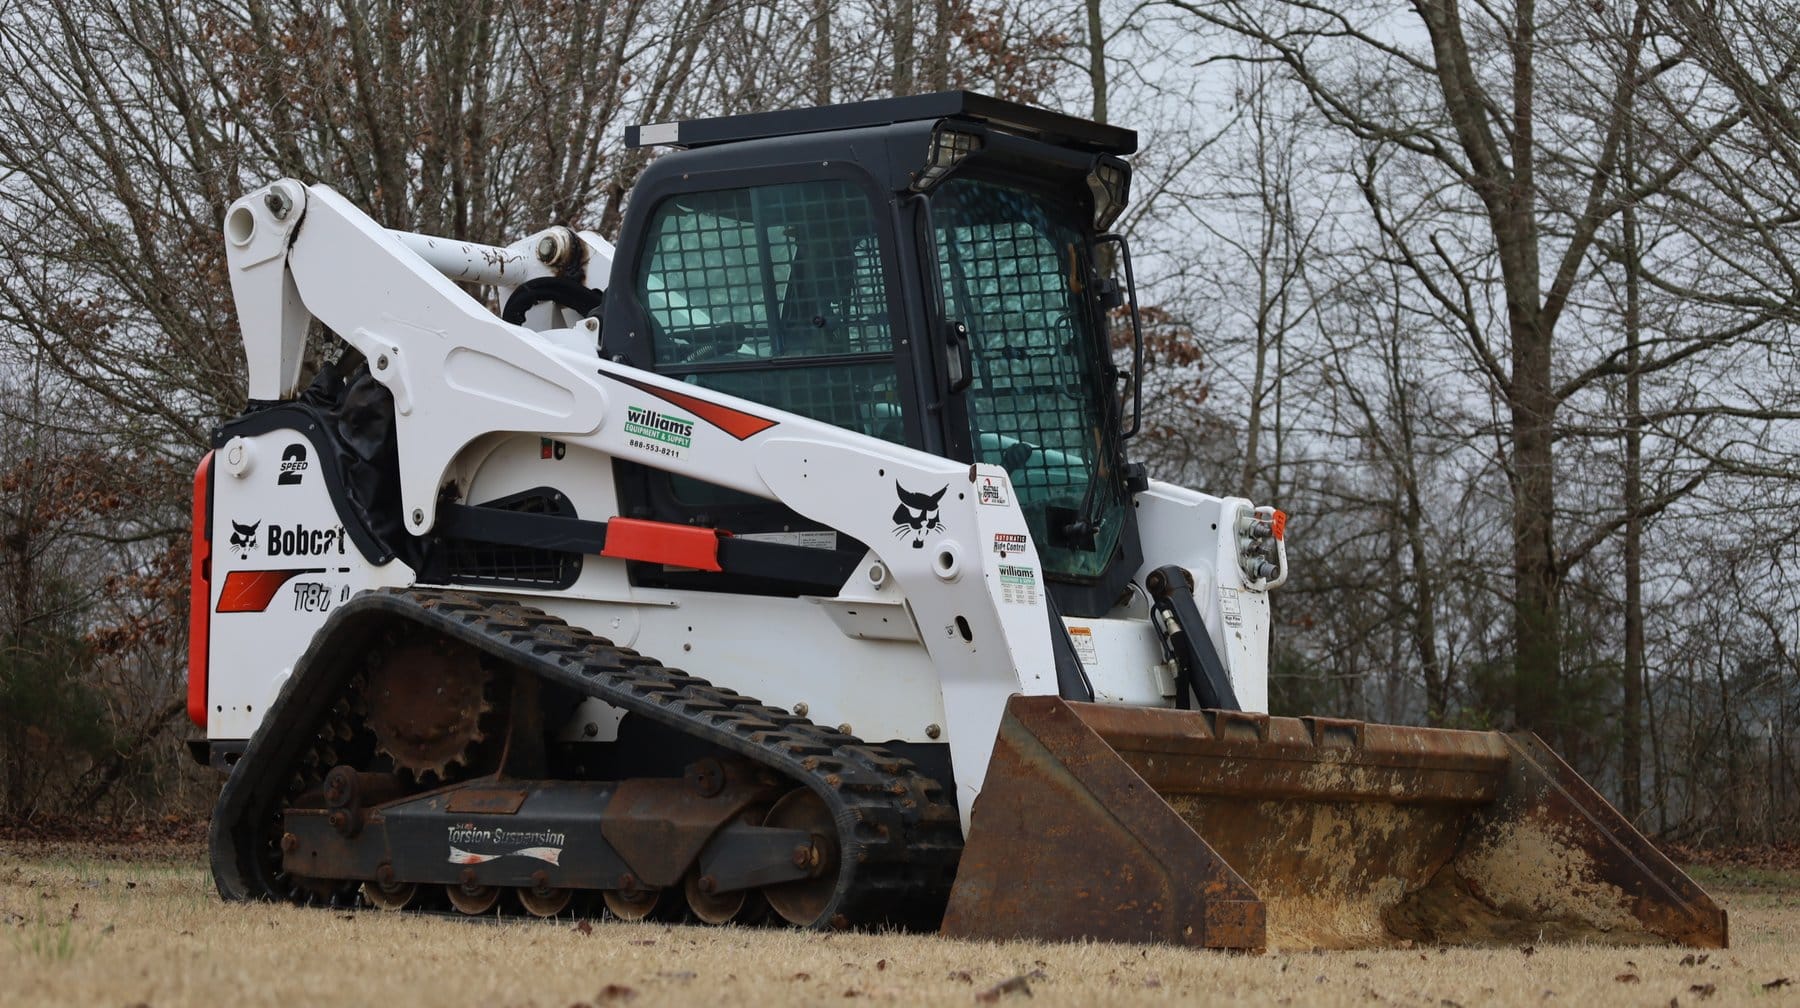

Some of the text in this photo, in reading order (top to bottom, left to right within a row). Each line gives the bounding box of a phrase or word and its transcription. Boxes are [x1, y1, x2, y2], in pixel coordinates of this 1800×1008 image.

[628, 410, 693, 437] williams
[625, 423, 660, 439] EQUIPMENT
[666, 435, 690, 447] SUPPLY
[629, 439, 680, 458] 888-553-8211
[278, 443, 307, 485] 2
[280, 462, 308, 471] SPEED
[268, 524, 346, 556] Bobcat
[995, 534, 1026, 542] AUTOMATIC
[1006, 543, 1026, 552] Control
[999, 565, 1034, 578] williams
[447, 827, 491, 843] Torsion
